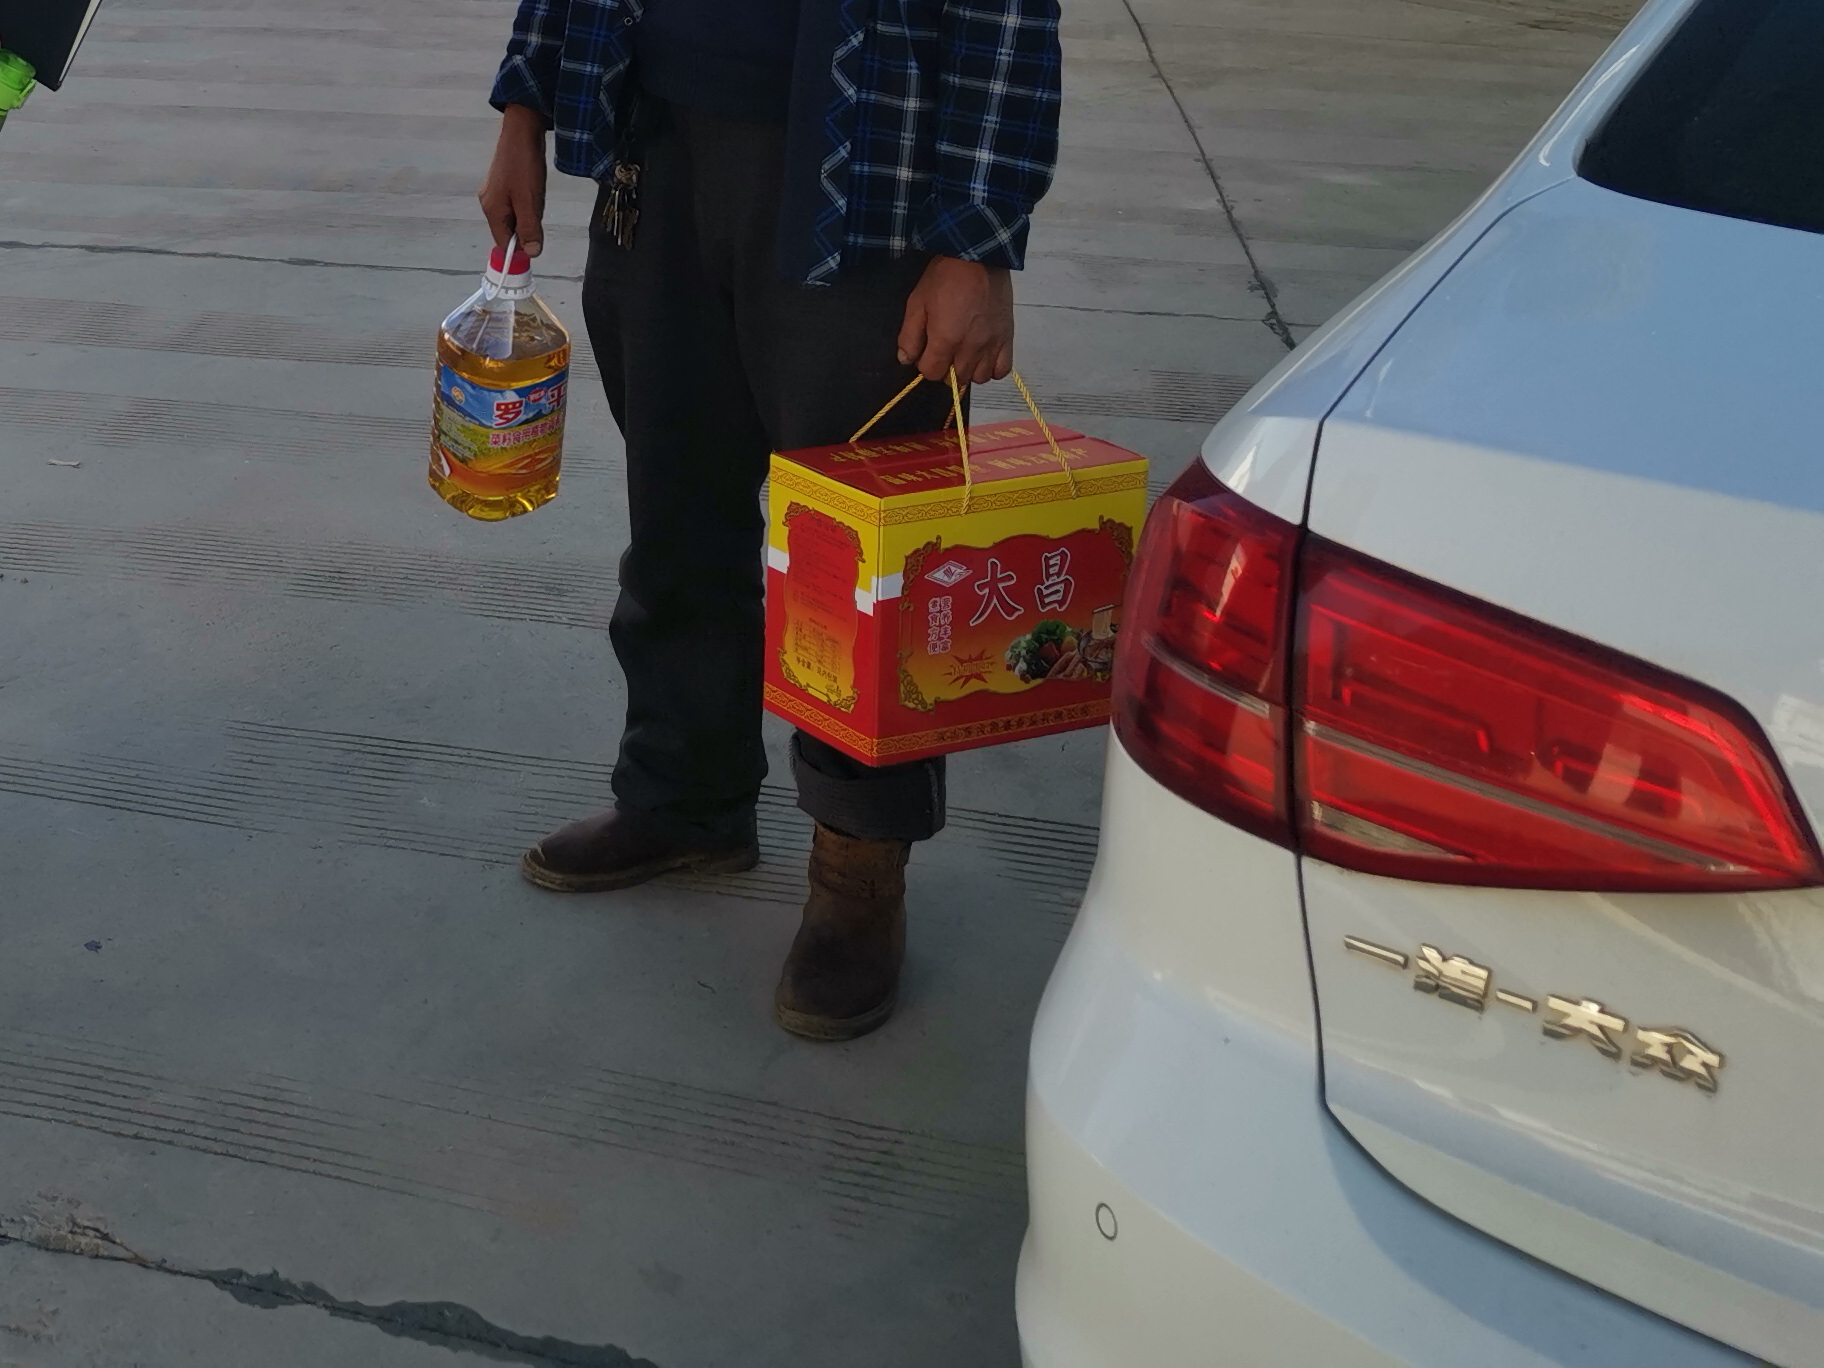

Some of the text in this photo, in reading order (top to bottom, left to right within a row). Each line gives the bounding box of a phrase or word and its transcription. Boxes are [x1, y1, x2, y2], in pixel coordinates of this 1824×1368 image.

[969, 548, 1076, 626] 大昌
[939, 595, 953, 653] 营养丰富
